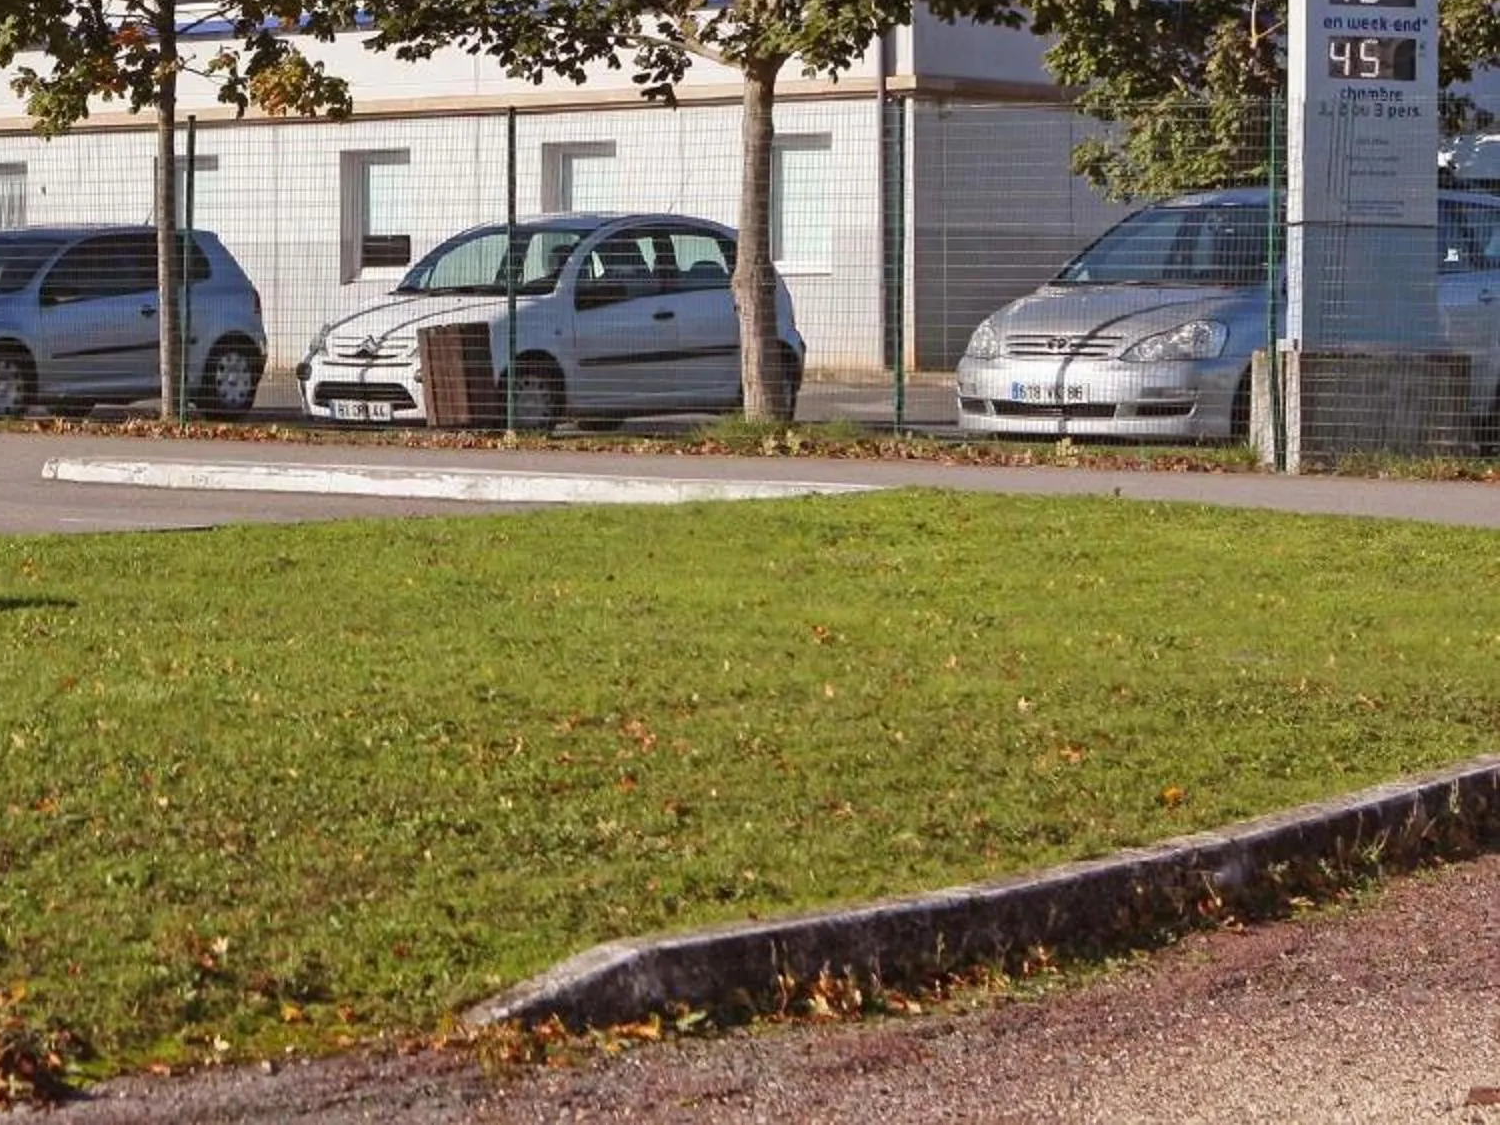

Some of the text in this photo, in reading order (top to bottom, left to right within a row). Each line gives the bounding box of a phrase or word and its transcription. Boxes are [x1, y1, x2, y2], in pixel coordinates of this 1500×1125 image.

[1323, 16, 1343, 30] en
[1329, 38, 1380, 78] 45
[1340, 85, 1404, 102] chambre
